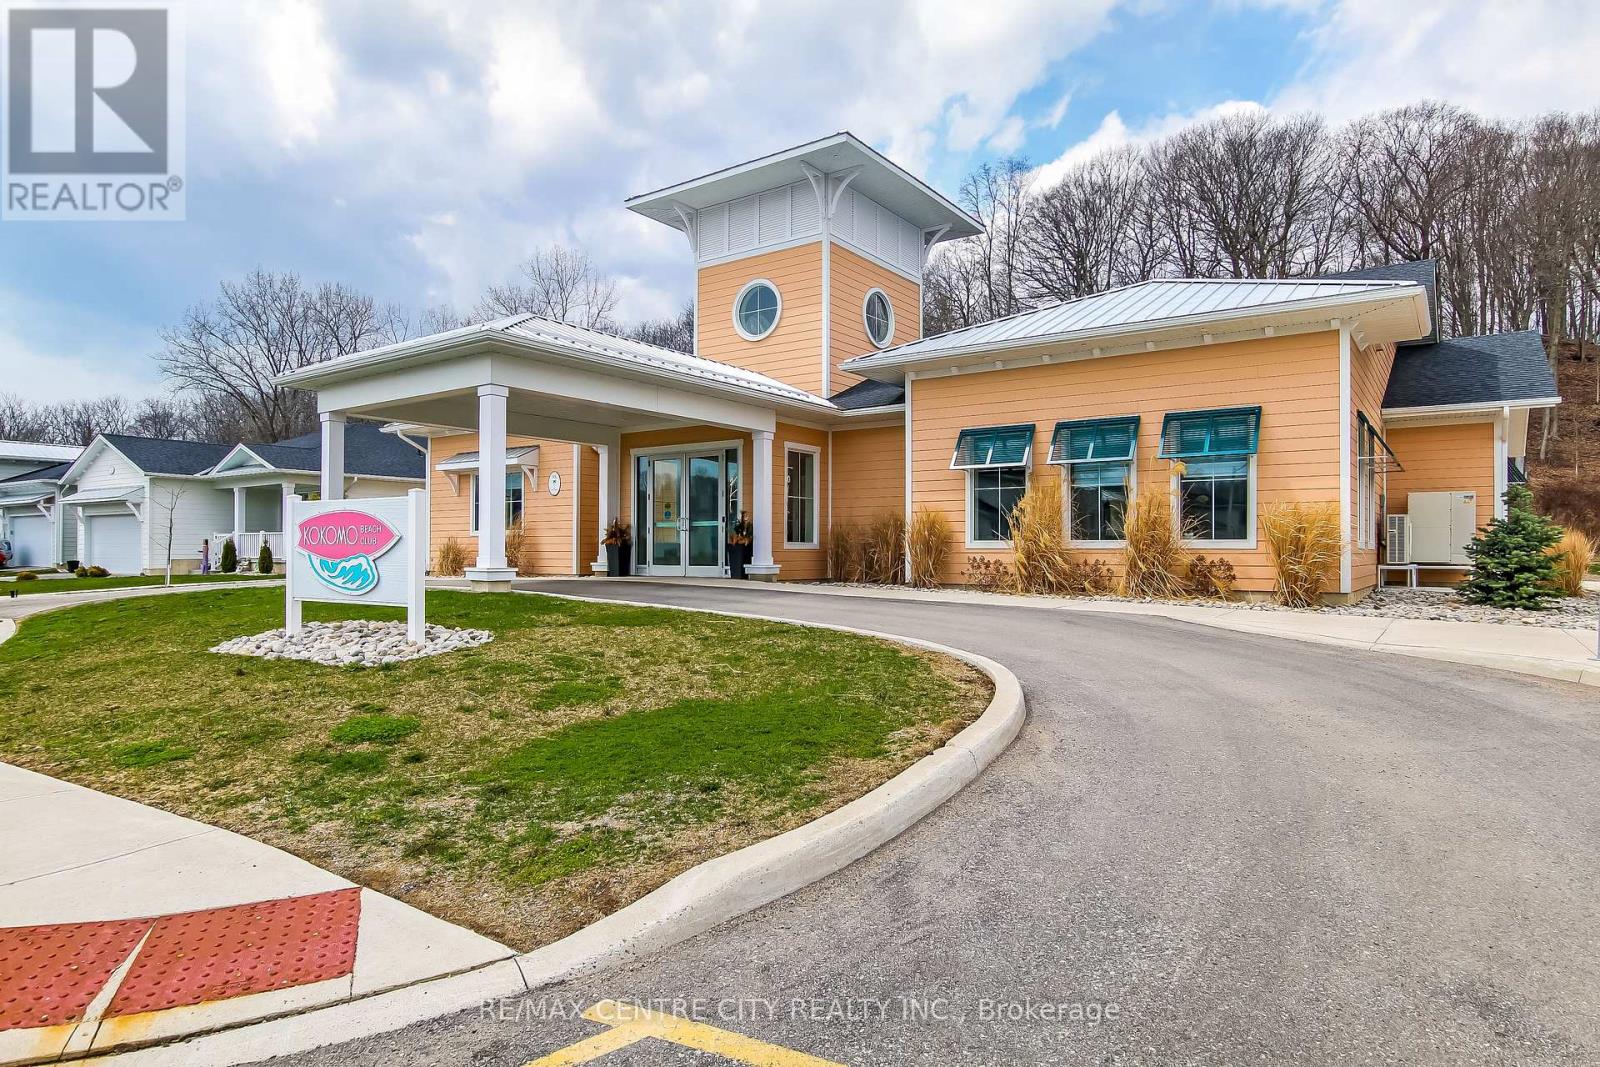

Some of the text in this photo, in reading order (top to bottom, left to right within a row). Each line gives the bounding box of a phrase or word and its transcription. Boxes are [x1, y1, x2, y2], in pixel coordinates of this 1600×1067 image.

[360, 524, 382, 533] BEACH
[303, 526, 359, 545] KOKOMO
[360, 537, 378, 545] CLUB
